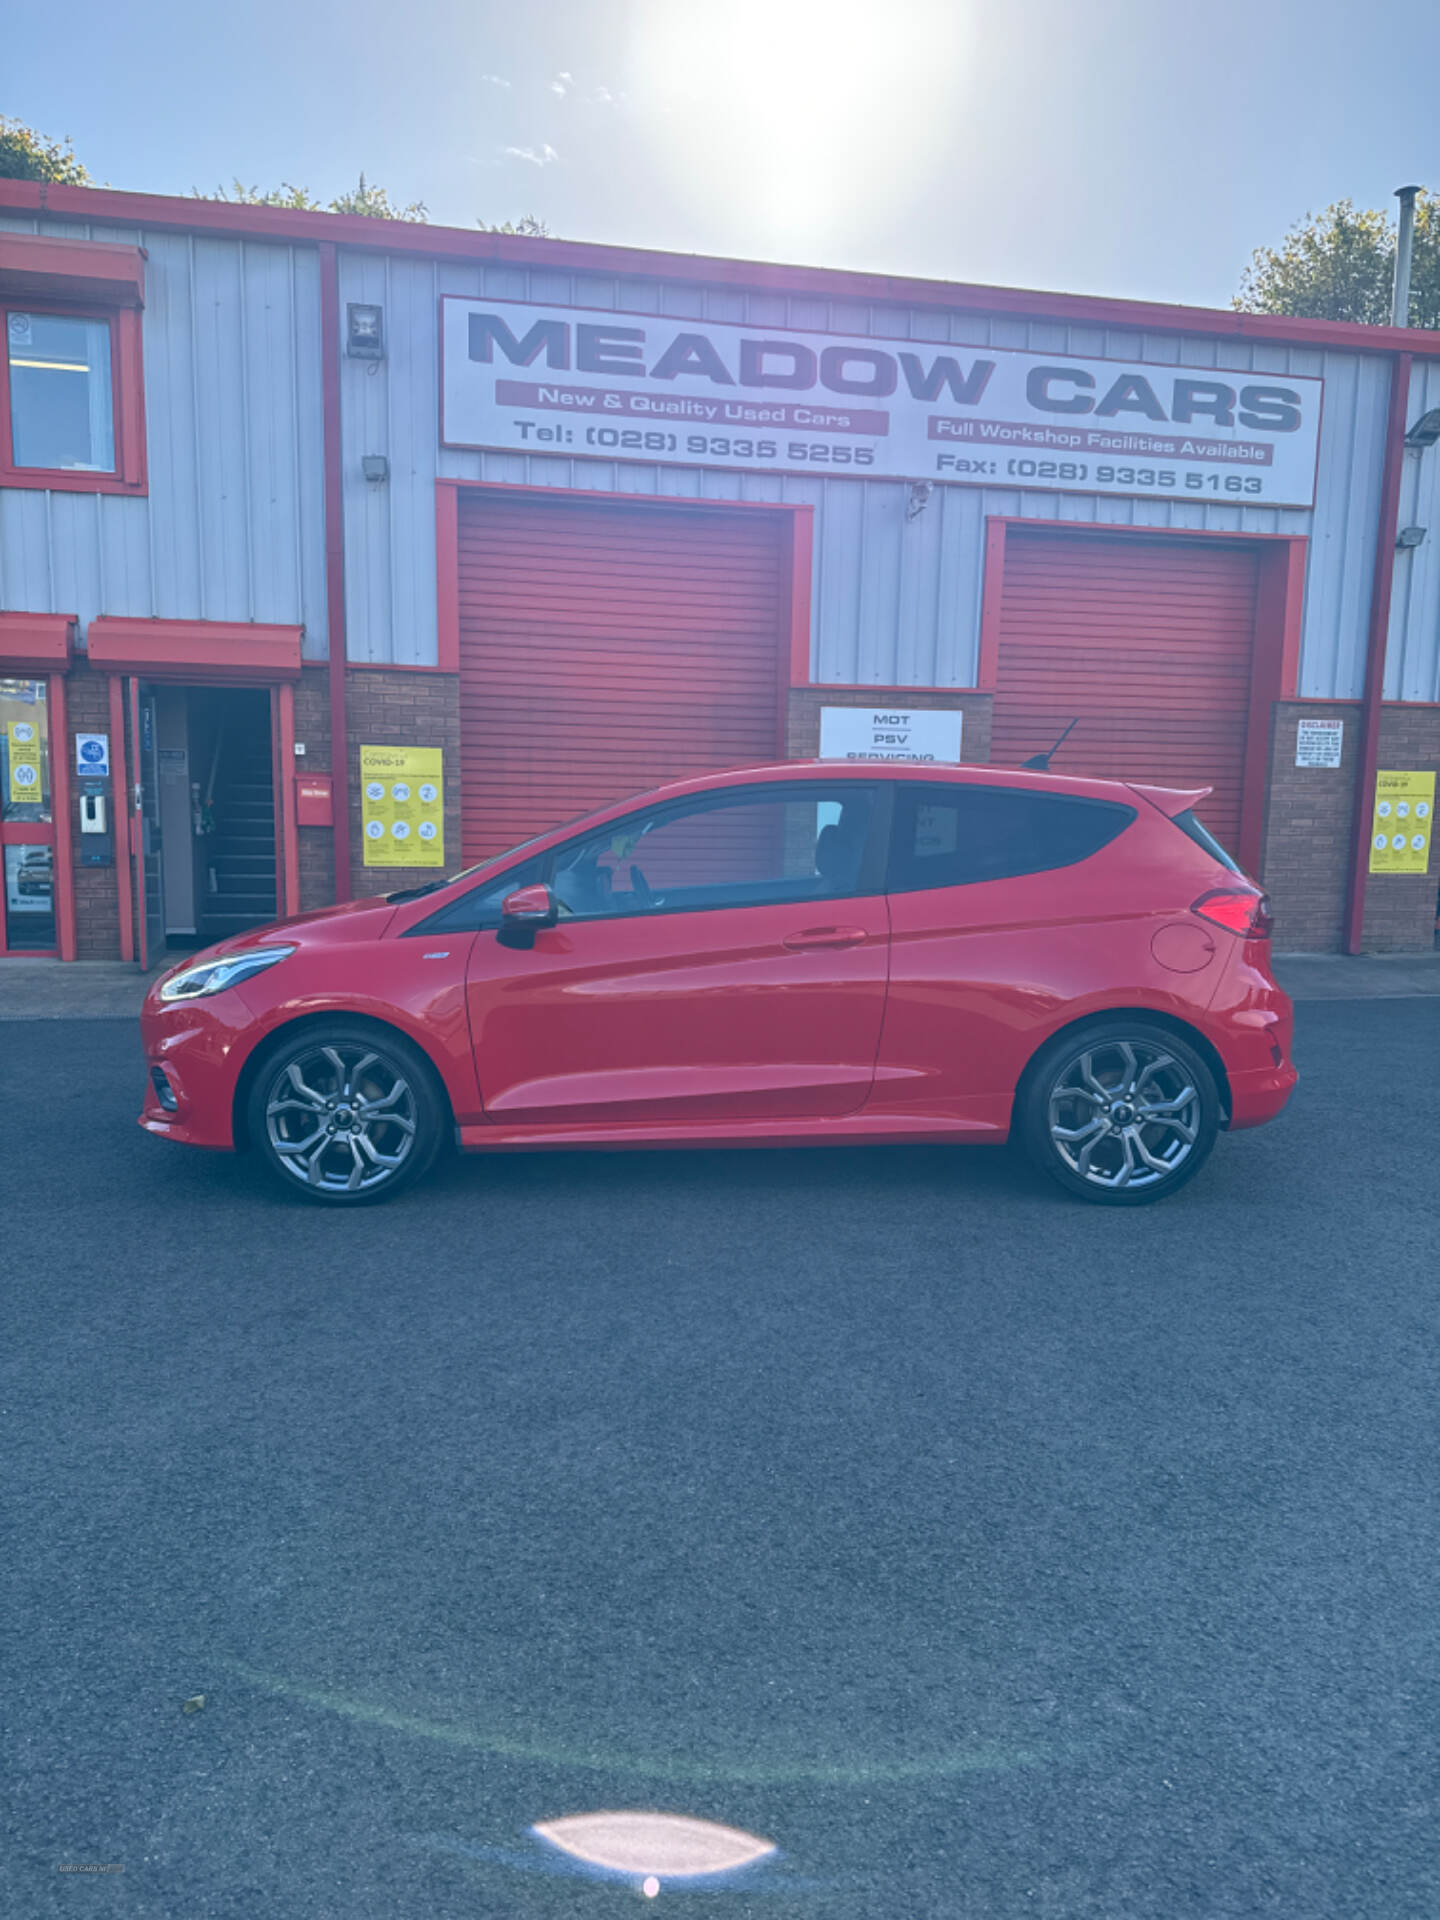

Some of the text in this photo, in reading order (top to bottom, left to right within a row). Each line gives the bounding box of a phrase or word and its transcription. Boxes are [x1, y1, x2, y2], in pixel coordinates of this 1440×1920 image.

[468, 311, 1302, 433] MEADOW CARS
[538, 387, 851, 428] New & Quality Used Cars
[513, 420, 875, 466] Tel: (028) 9335 5255
[937, 420, 1265, 460] Full Workshop Facilities Available
[936, 453, 1263, 495] Fax: (028) 9335 5163
[873, 715, 911, 725] MOT
[873, 734, 908, 744] PSV
[363, 758, 406, 766] COVID-19
